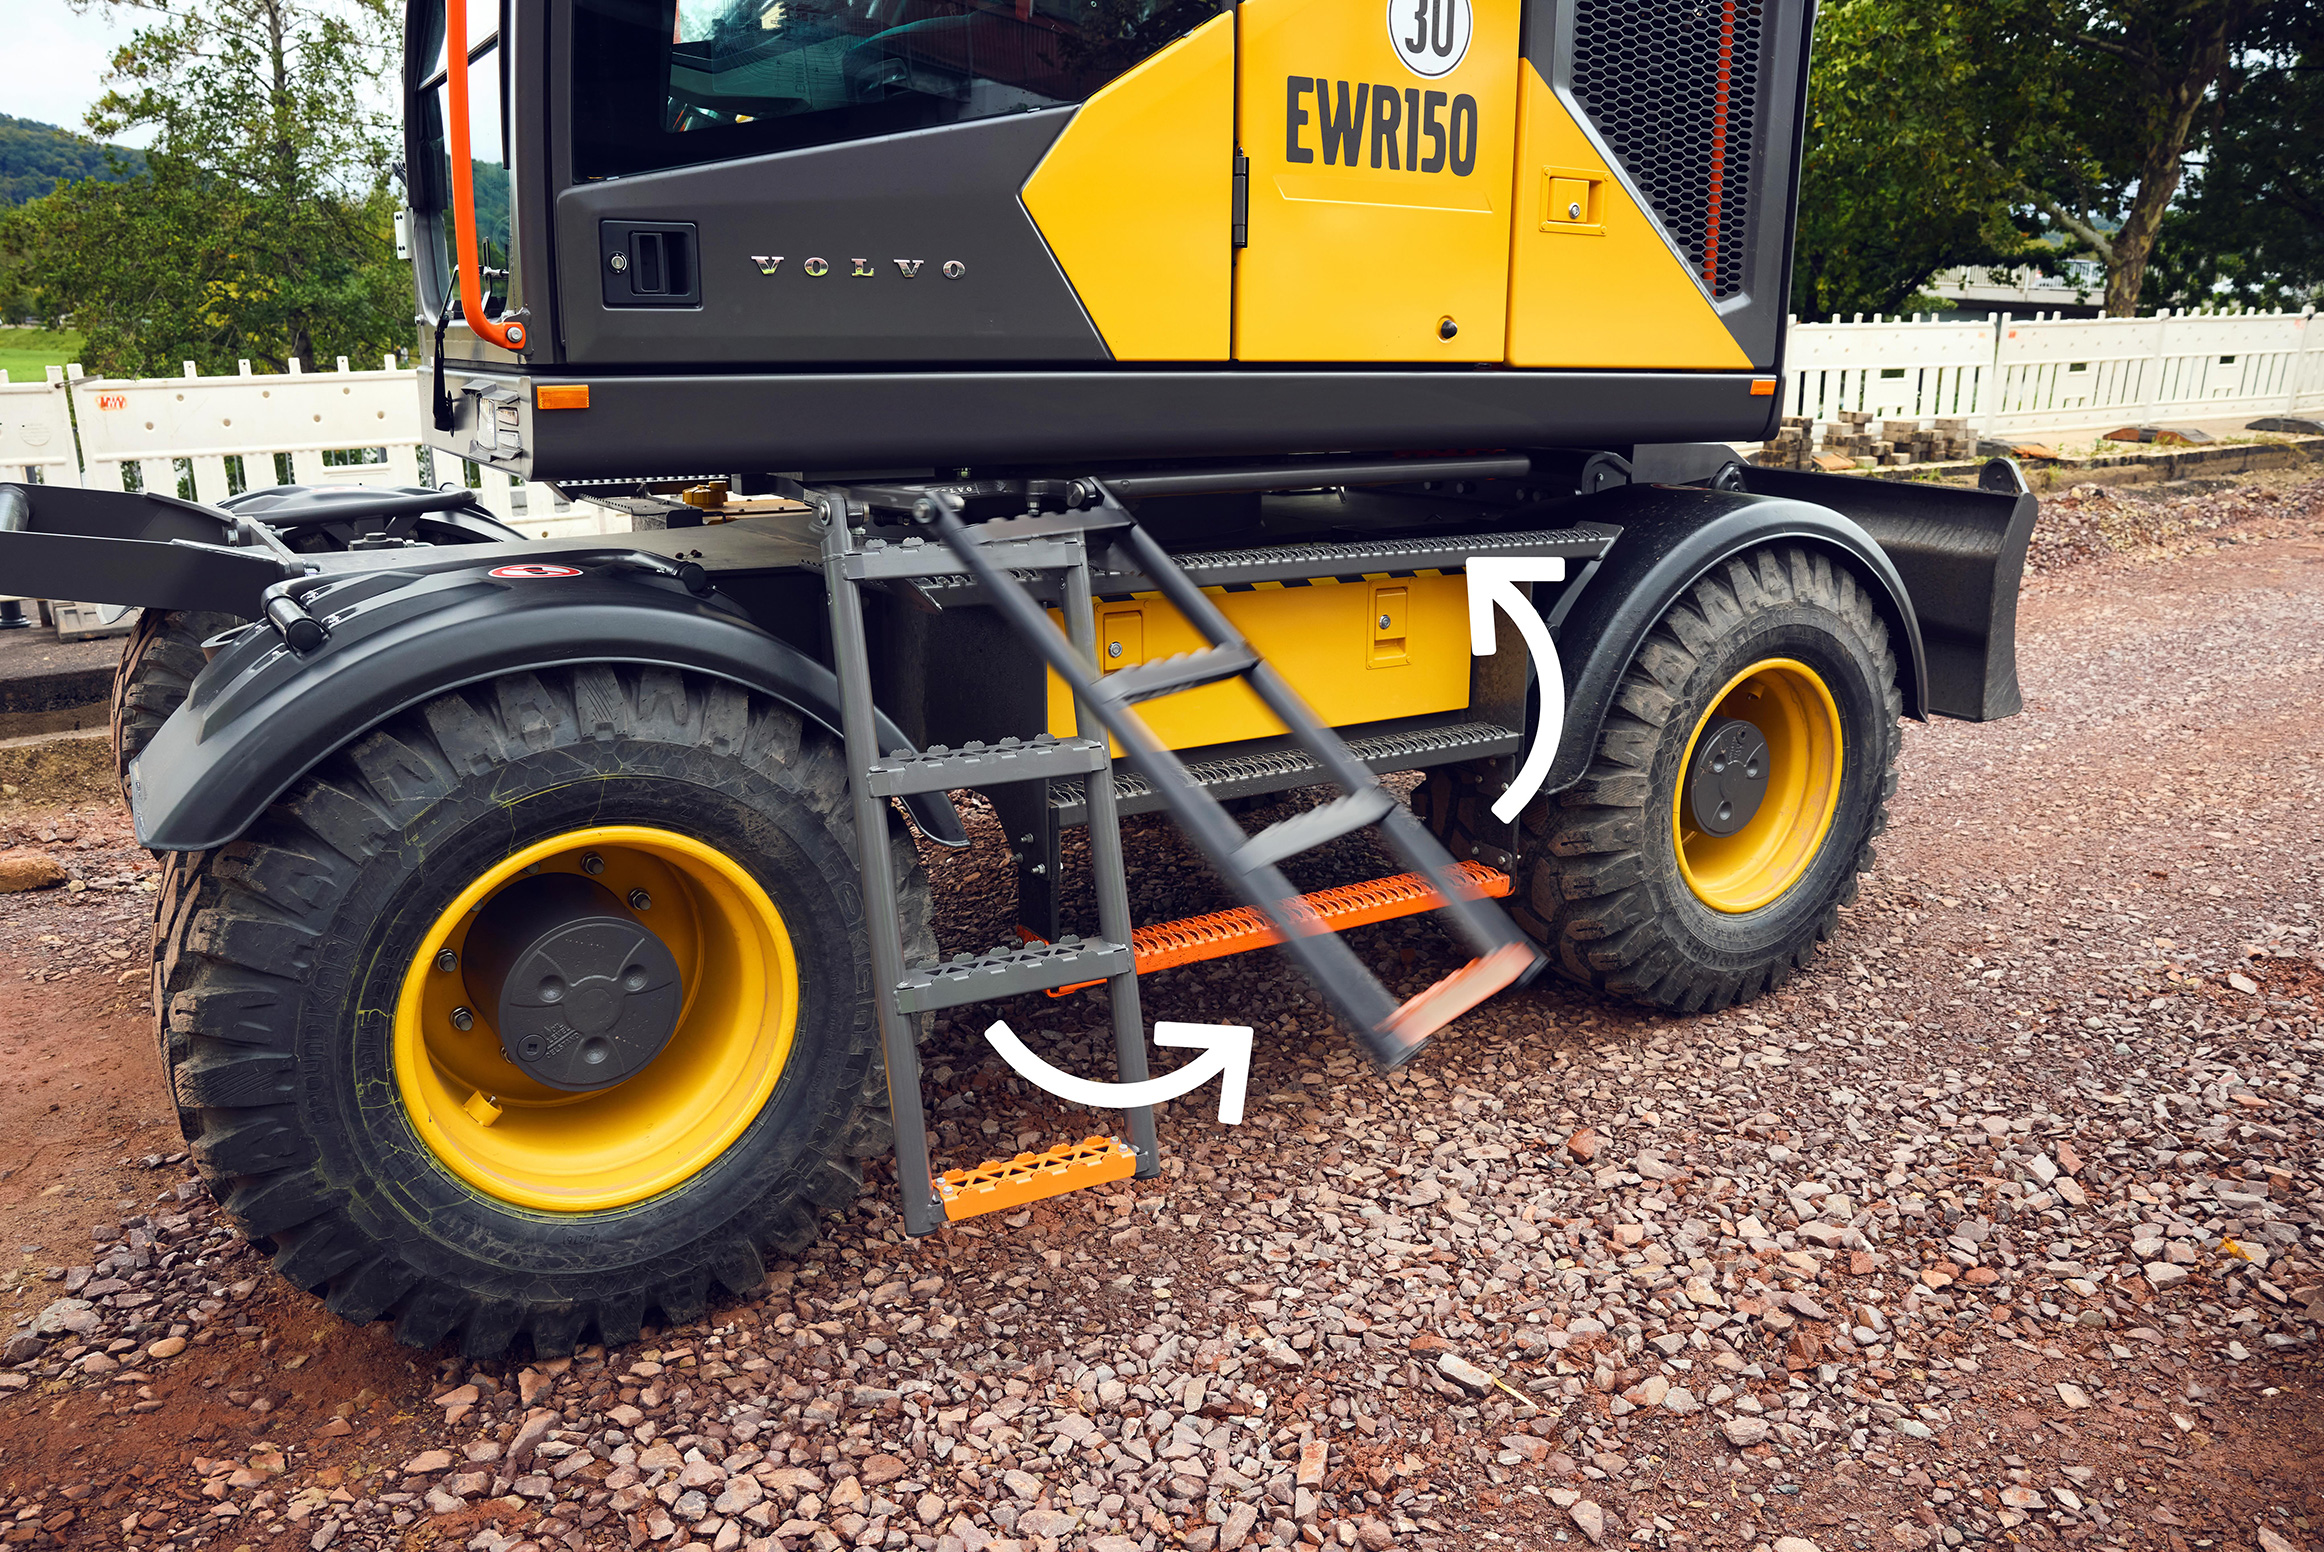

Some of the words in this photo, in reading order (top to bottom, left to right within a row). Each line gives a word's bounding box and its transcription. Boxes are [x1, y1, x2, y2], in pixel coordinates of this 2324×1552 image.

[1404, 0, 1455, 57] 30
[1286, 75, 1478, 177] EWR150
[751, 255, 966, 280] VOLVO
[305, 914, 367, 1018] KARE
